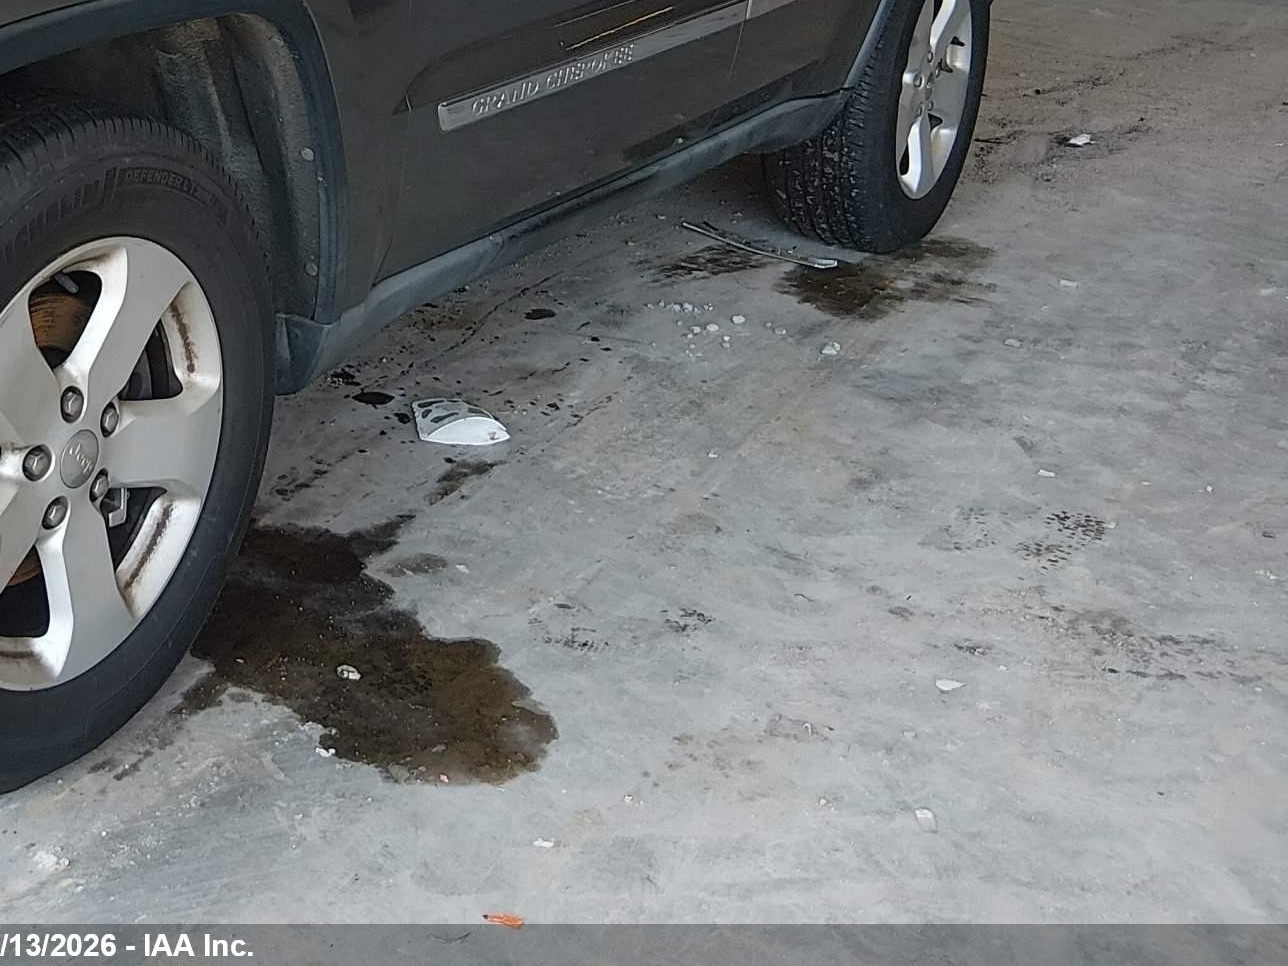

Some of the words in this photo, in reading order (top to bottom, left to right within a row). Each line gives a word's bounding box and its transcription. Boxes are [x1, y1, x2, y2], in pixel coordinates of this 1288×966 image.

[472, 81, 539, 116] GRAND
[546, 43, 635, 89] CHEROKEE
[125, 169, 183, 188] DEFENDER
